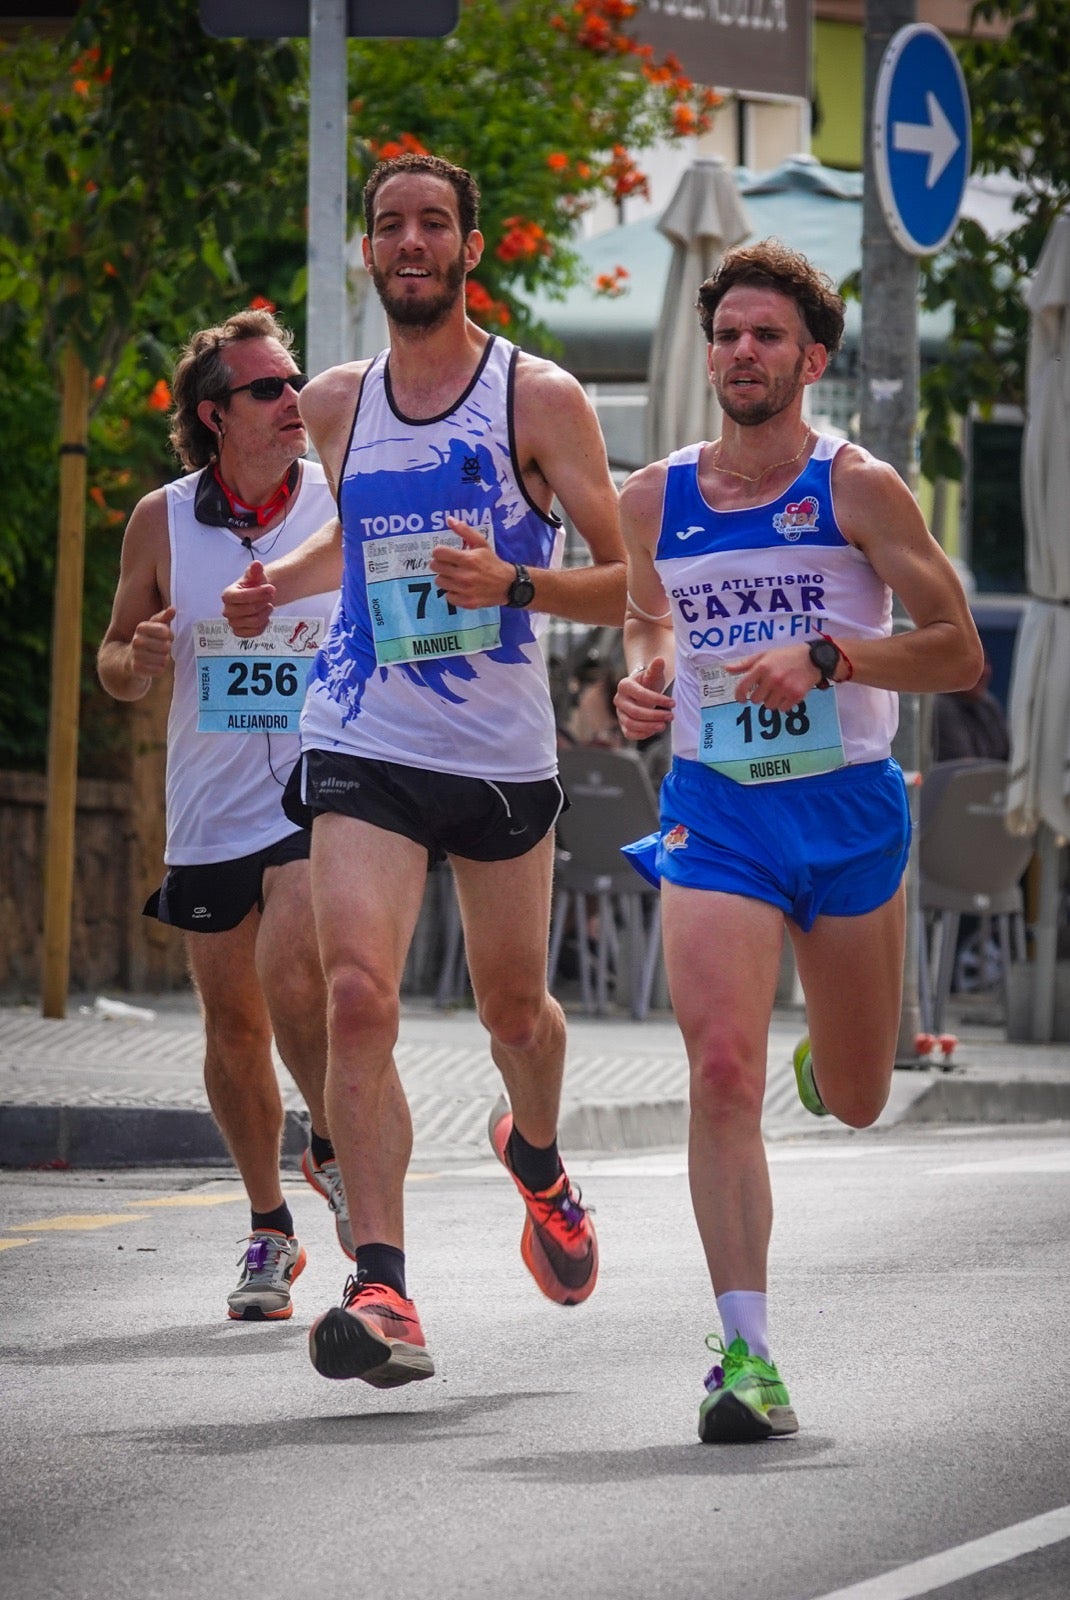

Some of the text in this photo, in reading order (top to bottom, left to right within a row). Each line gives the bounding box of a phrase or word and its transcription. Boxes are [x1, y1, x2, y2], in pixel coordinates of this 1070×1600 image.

[360, 507, 493, 537] TODO SUMA
[671, 574, 824, 599] CLUB ATLETISMO
[371, 598, 385, 626] SENIOR
[678, 586, 826, 624] CAXAR
[412, 635, 462, 656] MANUEL
[202, 672, 210, 701] MASTER
[227, 662, 298, 697] 256
[228, 714, 288, 729] ALEJANDRO
[703, 721, 714, 750] SENIOR
[735, 699, 811, 744] 198
[749, 759, 792, 779] RUBEN
